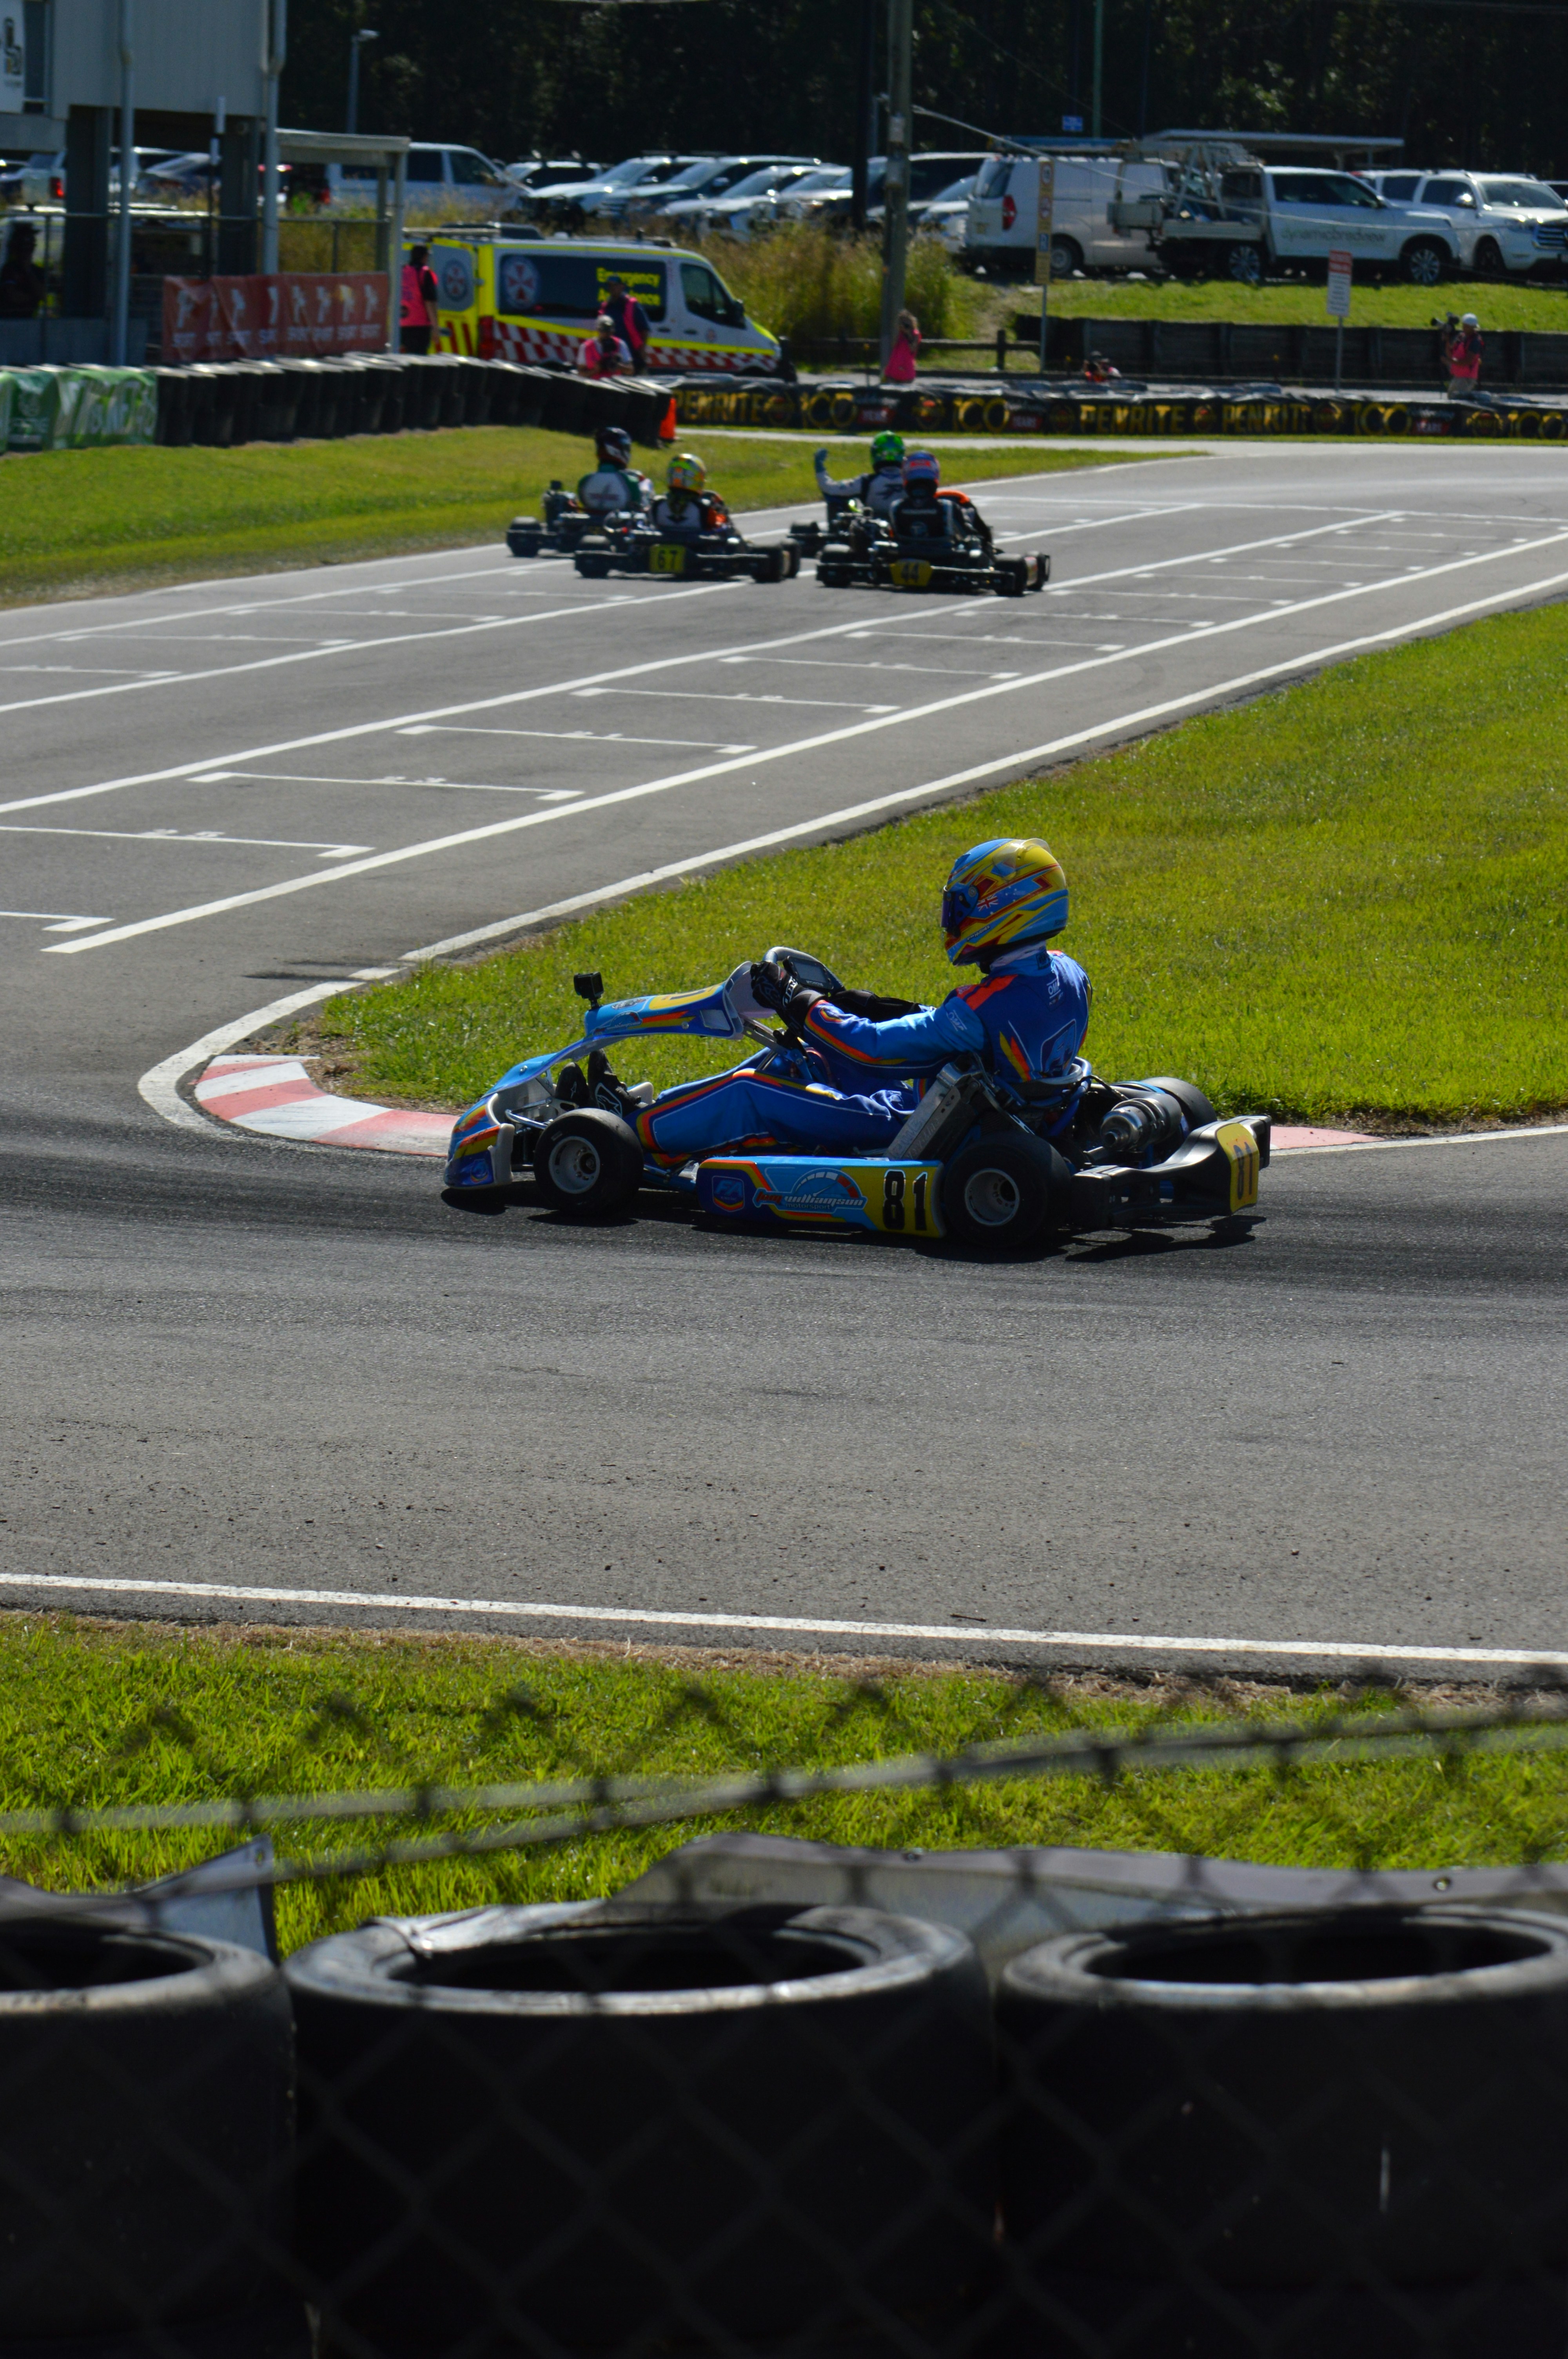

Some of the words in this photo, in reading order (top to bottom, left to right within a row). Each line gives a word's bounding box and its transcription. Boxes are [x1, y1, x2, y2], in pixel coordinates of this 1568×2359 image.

[1080, 404, 1186, 434] PENRITE
[658, 549, 678, 569] 67
[901, 563, 919, 583] 44
[1233, 1141, 1253, 1200] 81
[714, 1180, 742, 1197] FA
[784, 1194, 864, 1207] williamson
[883, 1169, 928, 1230] 81
